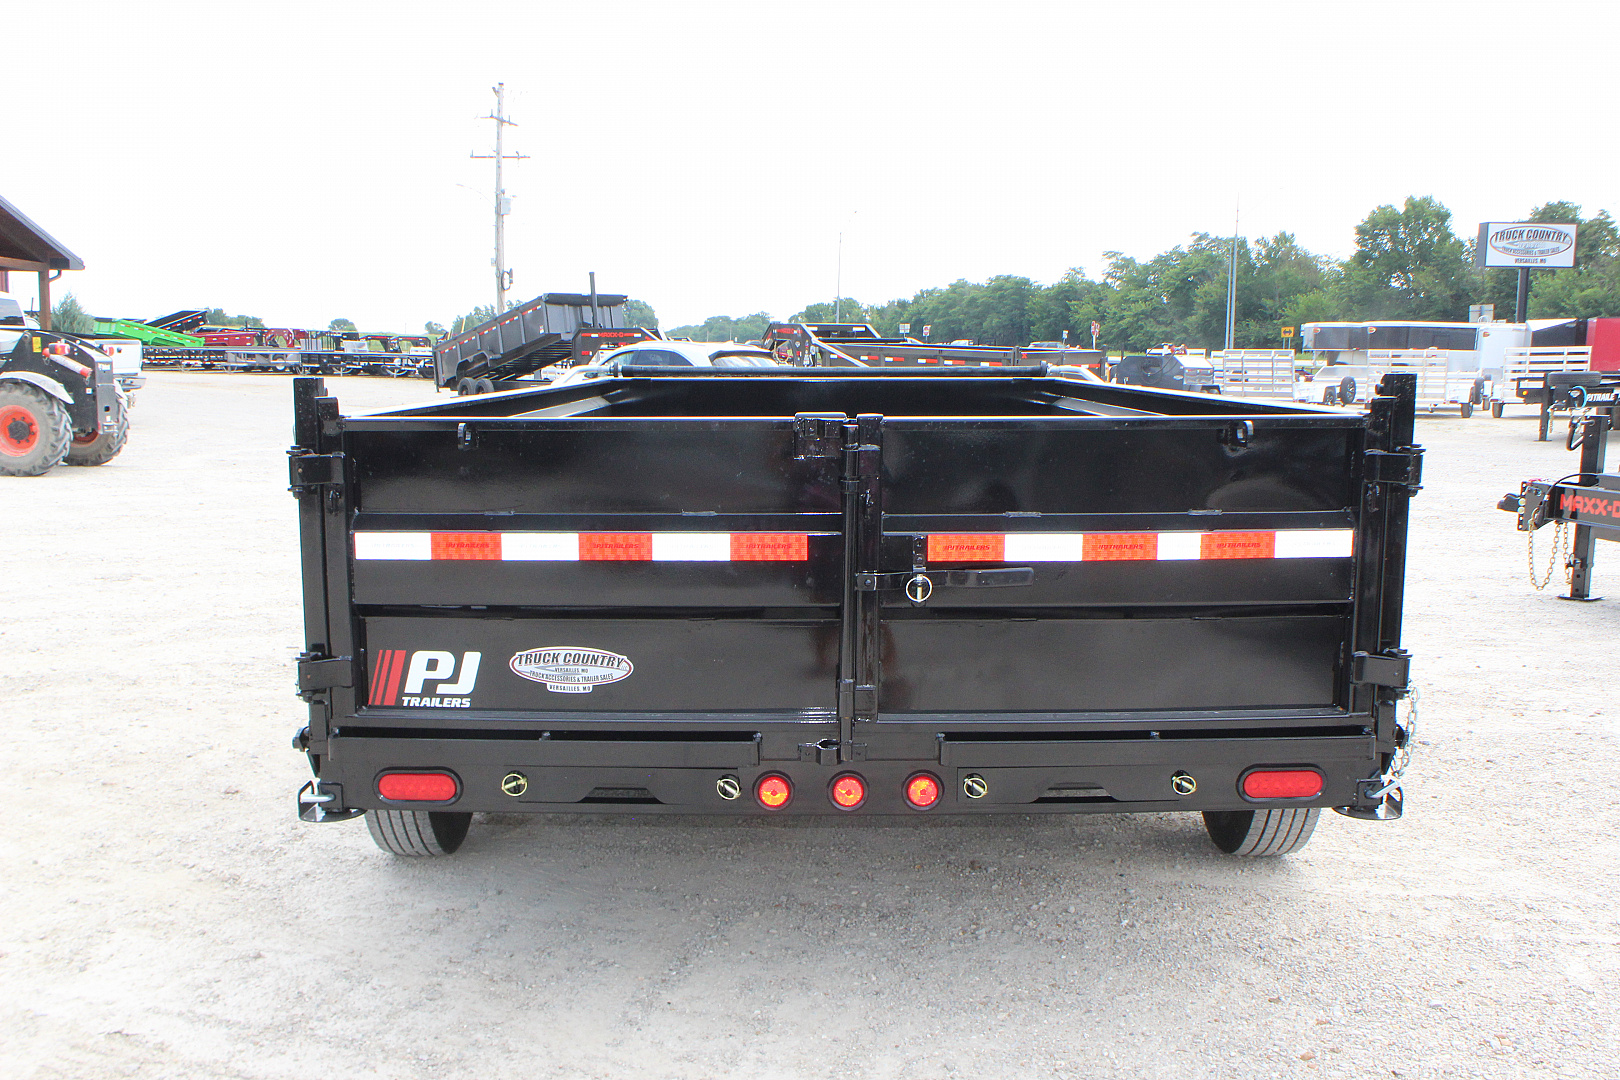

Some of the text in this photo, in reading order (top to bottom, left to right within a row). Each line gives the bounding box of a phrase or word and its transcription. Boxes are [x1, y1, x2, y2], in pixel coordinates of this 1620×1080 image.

[1494, 229, 1569, 243] TRUCK COUNTRY
[518, 652, 625, 669] TRUCK COUNTRY
[404, 650, 482, 695] PJ
[530, 670, 545, 679] TRUCK
[545, 673, 576, 683] ACCESSORIES
[581, 675, 600, 683] TRAILER
[600, 673, 614, 681] SALES
[402, 696, 471, 708] TRAILERS
